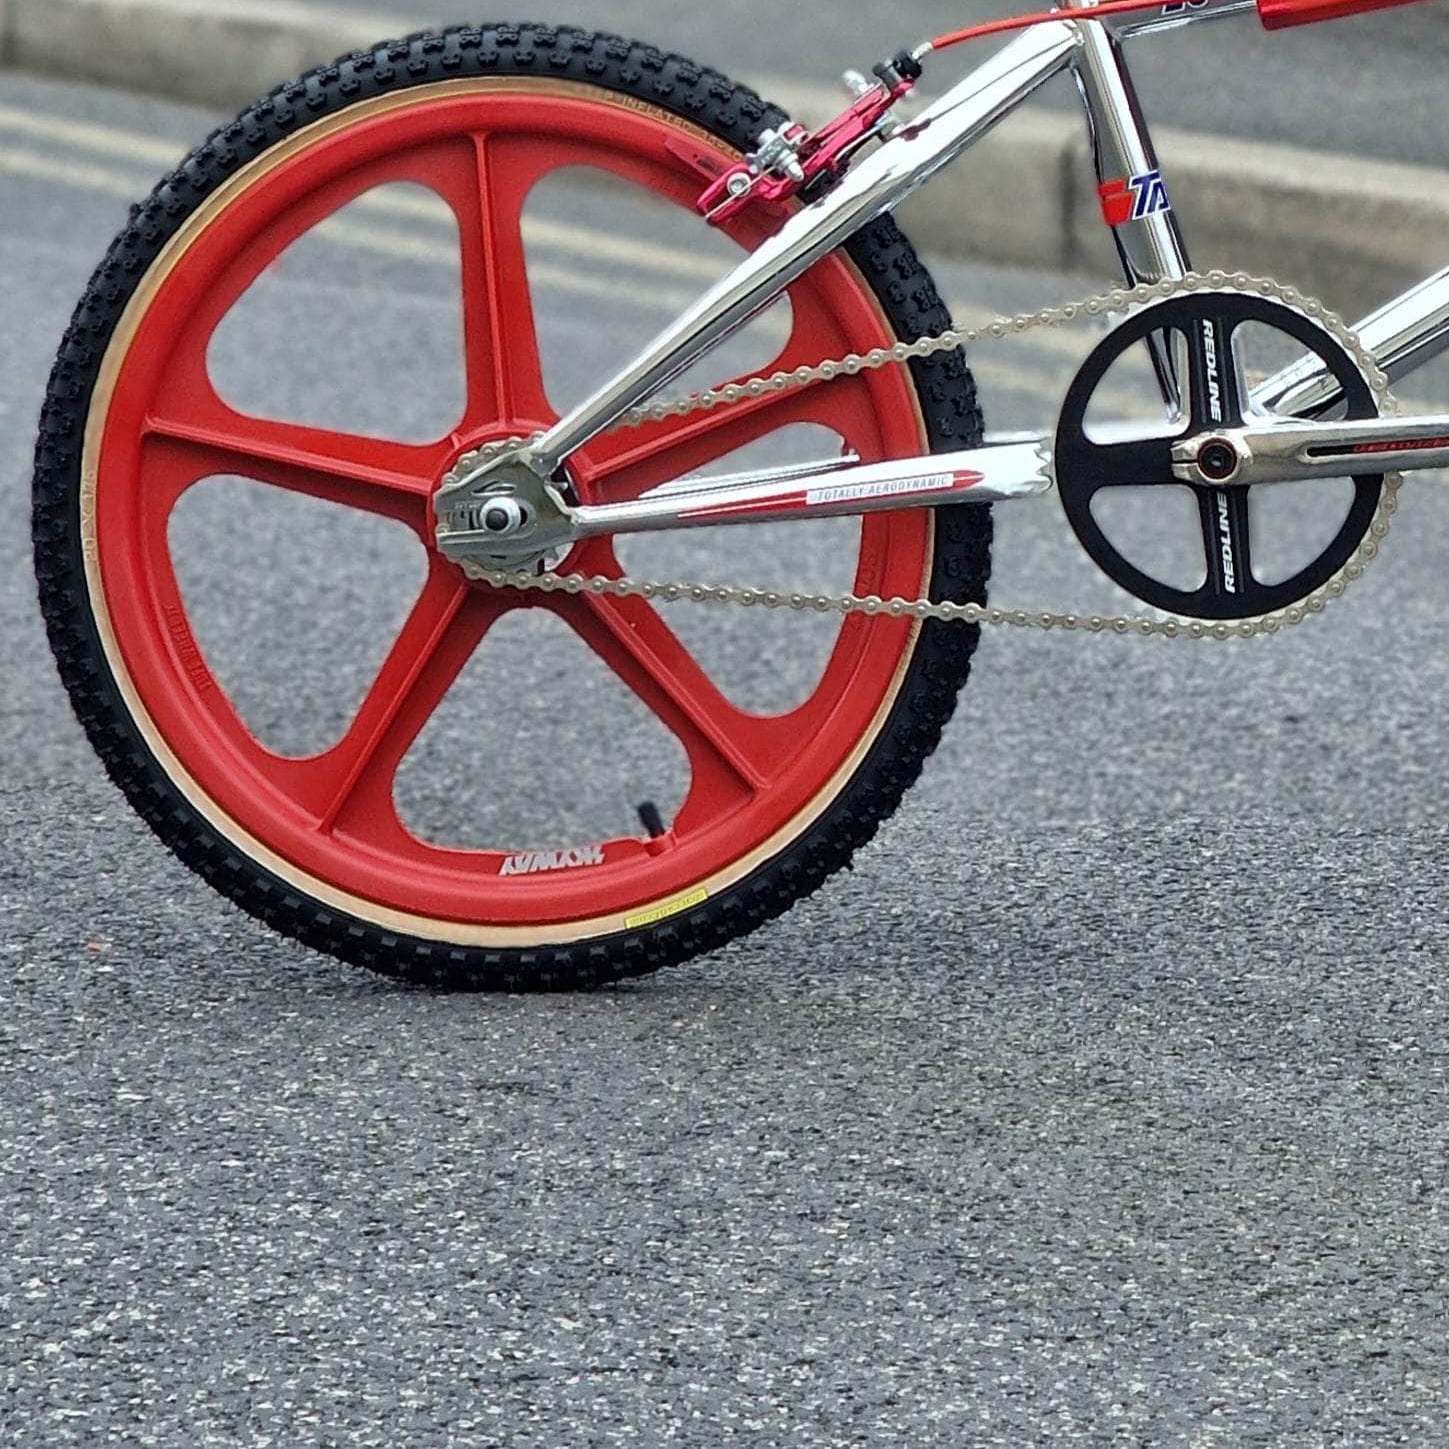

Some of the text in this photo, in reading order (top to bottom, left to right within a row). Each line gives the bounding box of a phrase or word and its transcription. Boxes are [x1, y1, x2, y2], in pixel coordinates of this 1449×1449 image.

[1128, 169, 1171, 220] TA
[1202, 318, 1222, 424] REDLINE
[1217, 491, 1236, 594] REDLINE
[499, 846, 605, 876] SKYWAY
